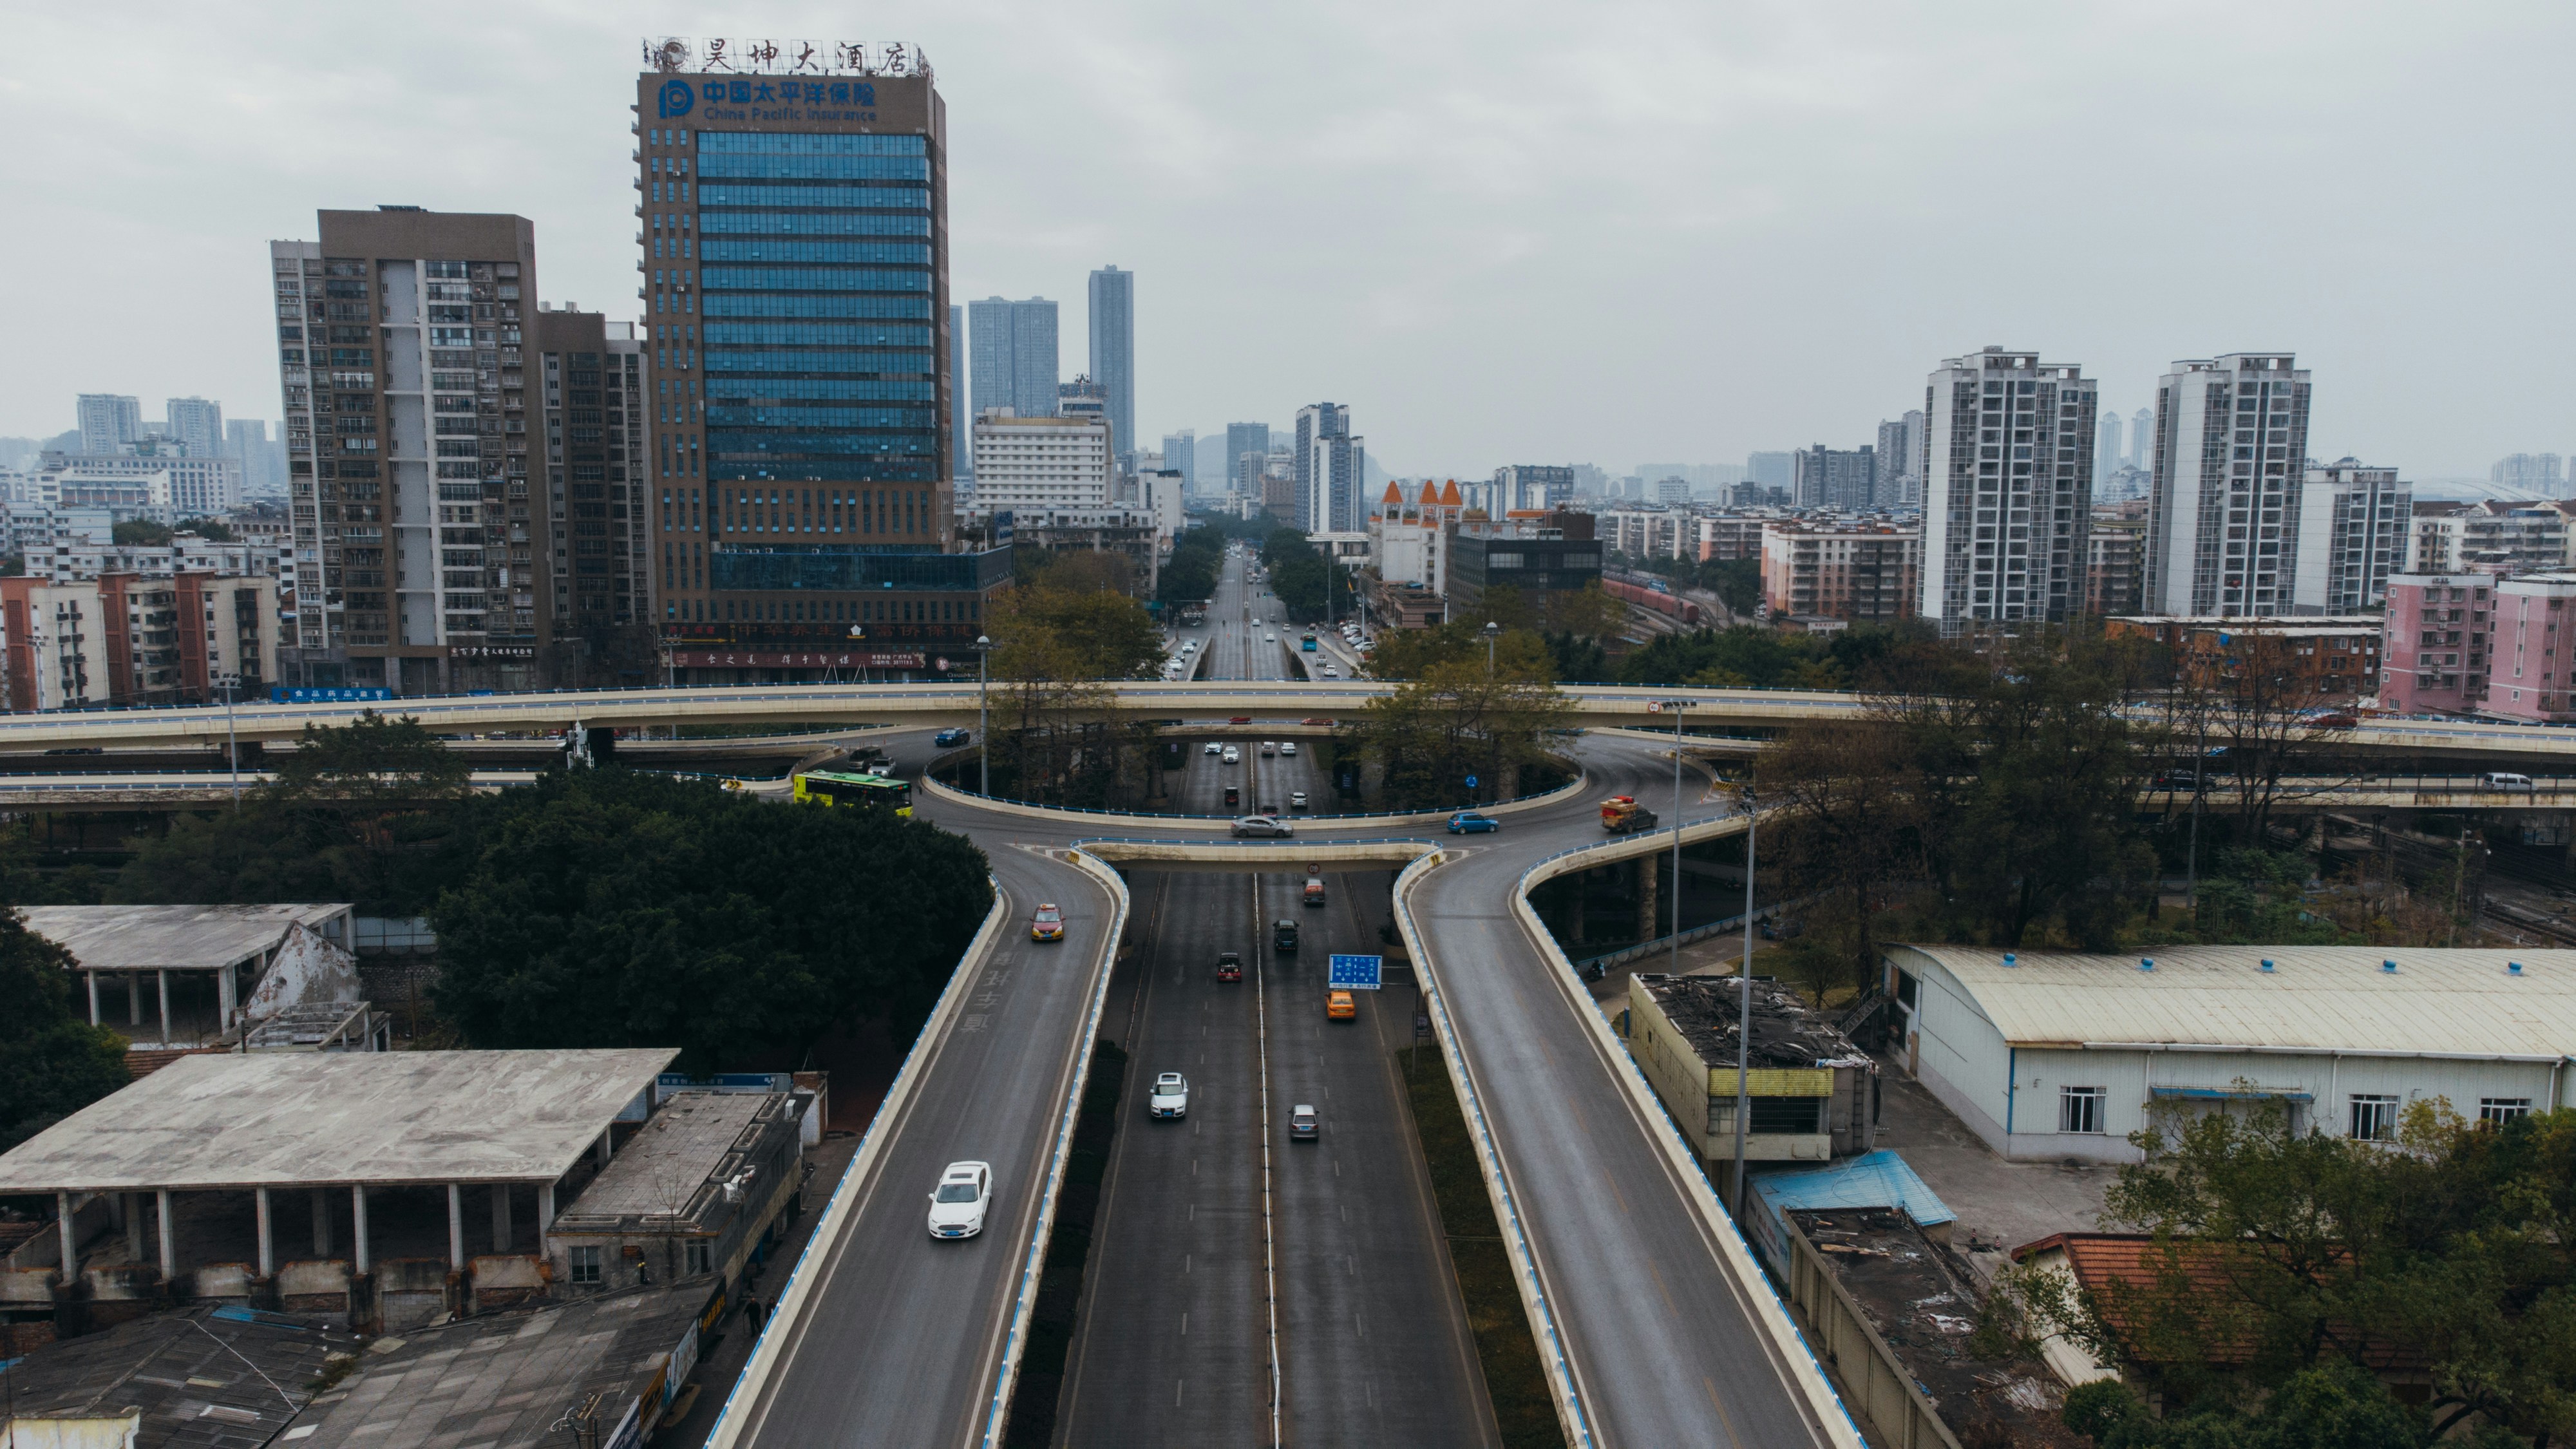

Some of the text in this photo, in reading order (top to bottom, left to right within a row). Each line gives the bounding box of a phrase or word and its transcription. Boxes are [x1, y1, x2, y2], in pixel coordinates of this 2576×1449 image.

[706, 38, 907, 73] 昊坤大酒店
[703, 80, 875, 106] 中国太平洋保险
[704, 107, 876, 121] China Pacific Insurance
